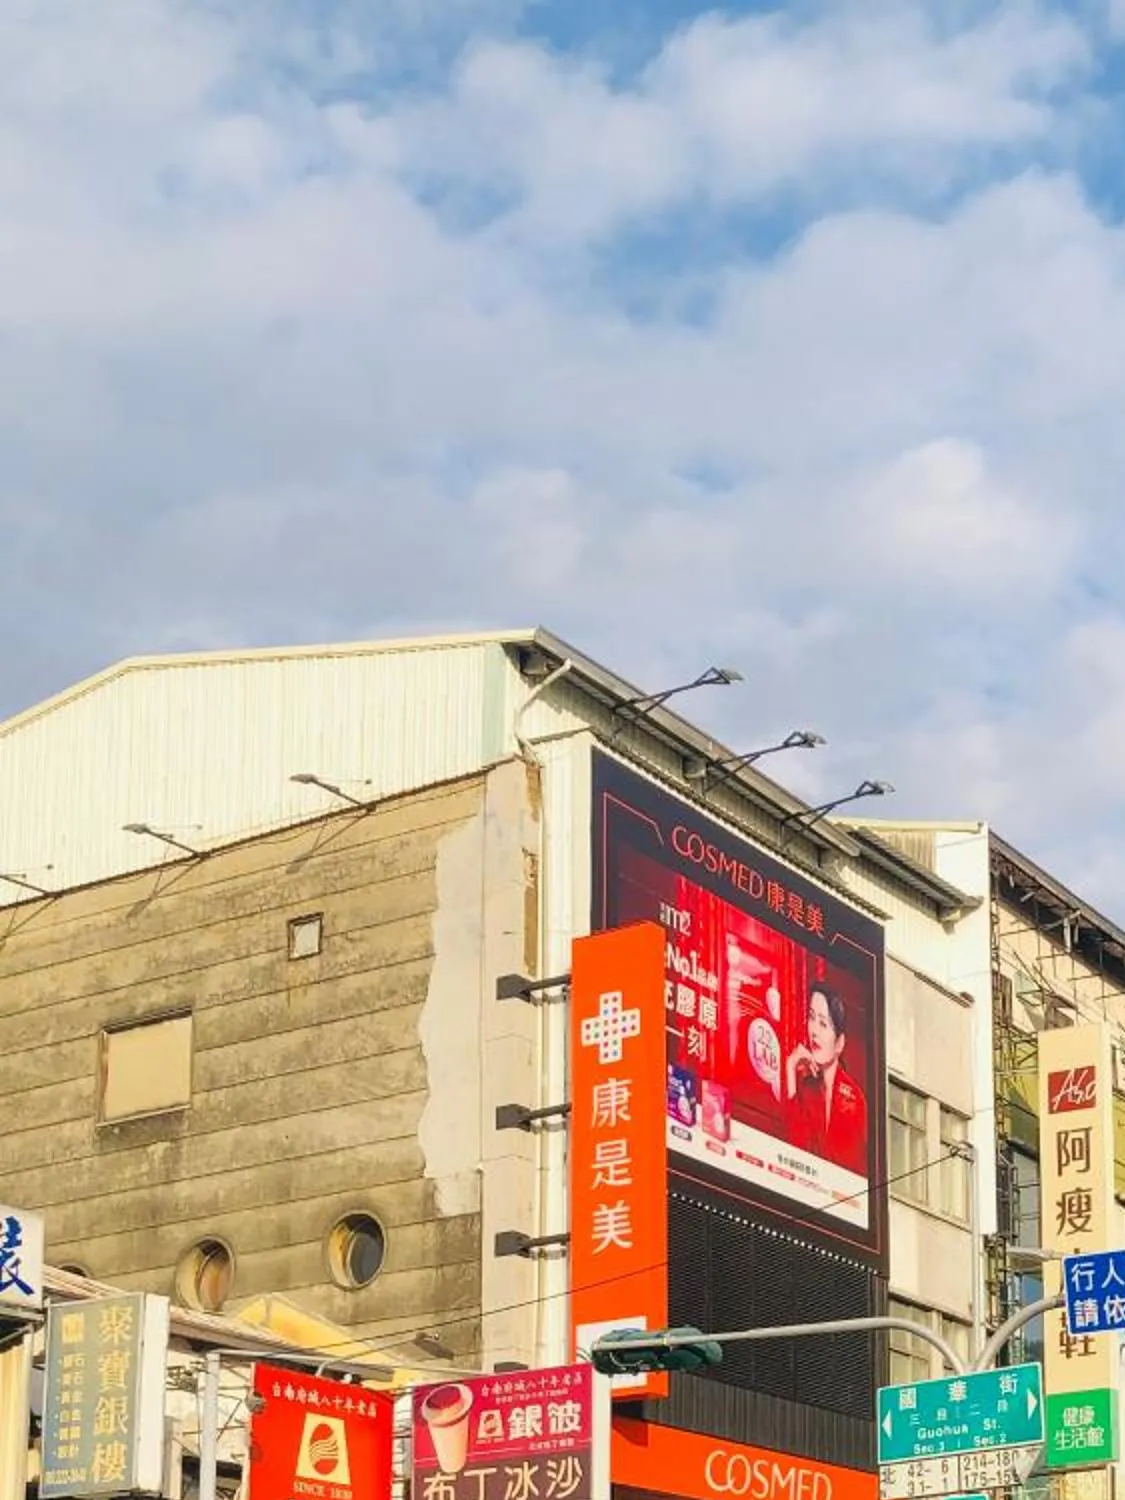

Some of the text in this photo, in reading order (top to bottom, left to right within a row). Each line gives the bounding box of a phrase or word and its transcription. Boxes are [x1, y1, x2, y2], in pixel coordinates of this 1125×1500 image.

[672, 825, 825, 939] COSMED 康是美
[591, 1077, 634, 1256] 康是美
[92, 1306, 133, 1483] 聚寶銀樓
[508, 1400, 583, 1441] 銀波
[917, 1424, 969, 1440] Guohua
[1063, 1405, 1095, 1428] 健康
